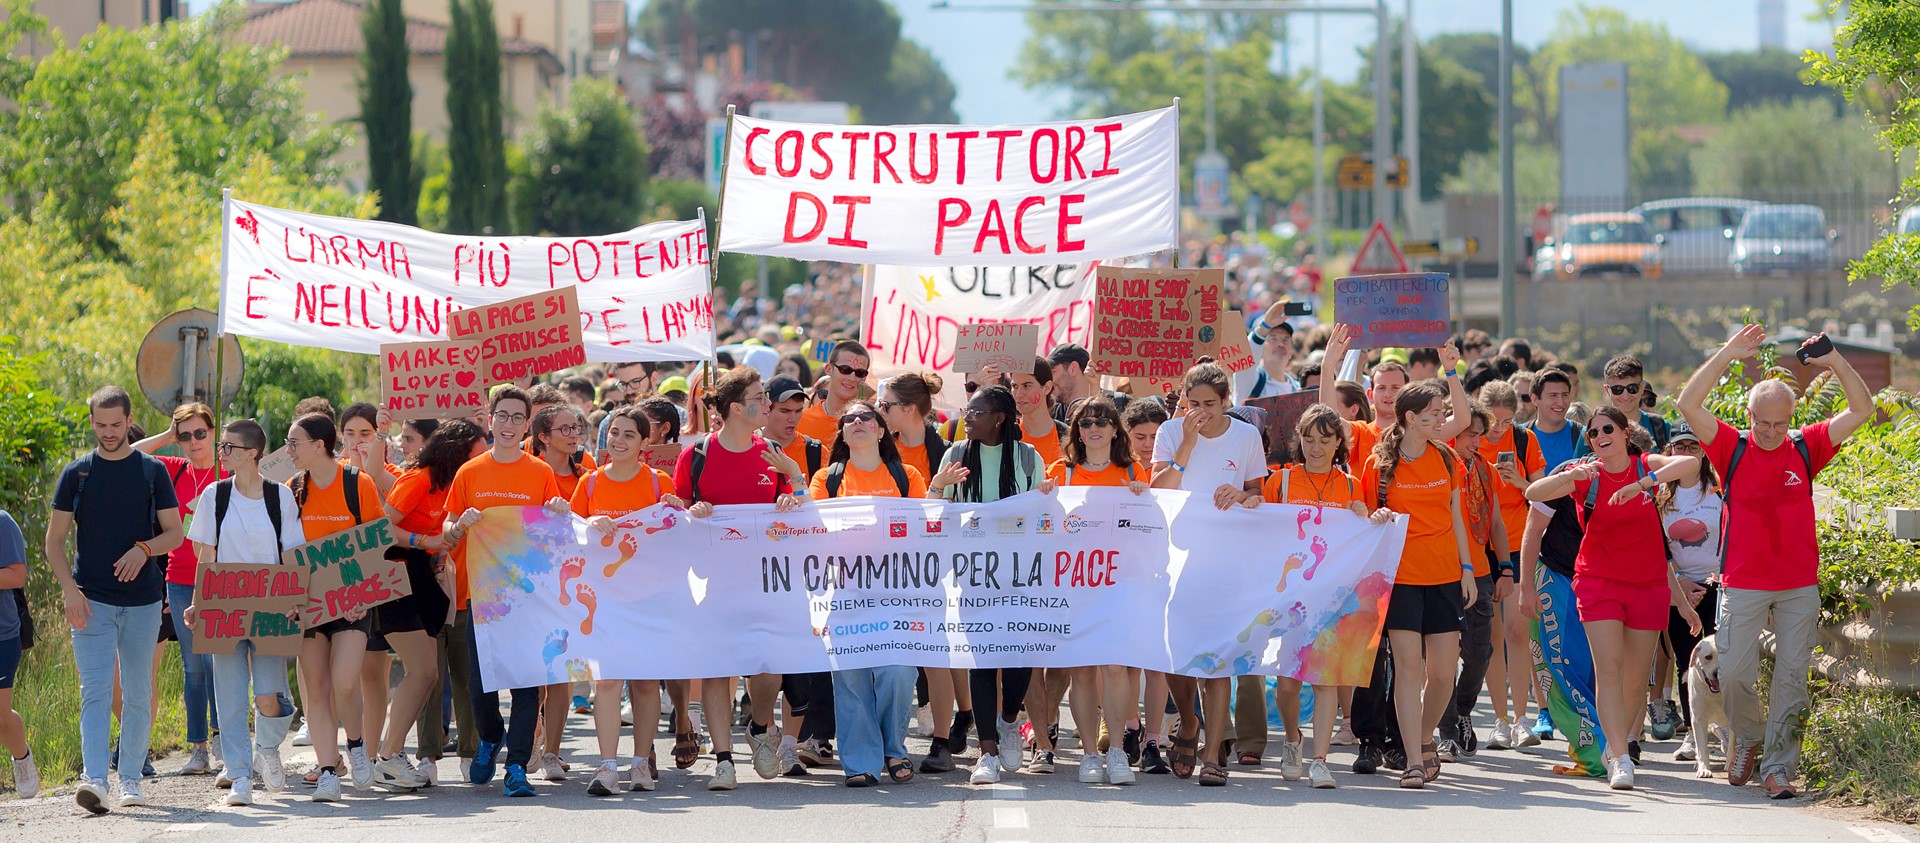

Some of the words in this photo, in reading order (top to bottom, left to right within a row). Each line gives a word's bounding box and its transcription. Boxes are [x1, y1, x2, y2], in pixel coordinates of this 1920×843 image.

[744, 122, 1123, 185] COSTRUTTORI
[782, 190, 871, 249] DI
[934, 194, 1086, 255] PACE
[284, 226, 412, 280] L'ARMA
[454, 240, 512, 288] PIÙ
[548, 226, 712, 288] POTENTE
[1097, 277, 1119, 297] MA
[1123, 279, 1150, 298] NON
[1337, 278, 1449, 294] COMBATTEREMO
[1346, 296, 1367, 306] PER
[1373, 296, 1386, 305] LA
[1379, 306, 1420, 315] QUANDO
[453, 310, 483, 337] LA
[487, 301, 536, 330] PACE
[544, 294, 566, 319] SI
[976, 325, 1023, 338] PONTI
[1345, 323, 1363, 335] ON
[482, 324, 570, 360] STRUISCE
[973, 340, 1006, 352] MURI
[388, 347, 460, 372] MAKE
[392, 373, 450, 391] LOVE
[388, 393, 429, 410] NOT
[436, 391, 482, 408] WAR
[811, 526, 828, 534] Fest
[295, 533, 355, 574] LIVING
[339, 558, 364, 587] IN
[761, 555, 791, 593] IN
[803, 551, 940, 592] CAMMINO
[952, 551, 1001, 590] PER
[1011, 551, 1043, 587] LA
[1054, 549, 1120, 588] PACE
[202, 568, 270, 600] IMAGINE
[270, 571, 305, 596] ALL
[325, 573, 391, 617] PEACE
[813, 598, 876, 612] INSIEME
[880, 597, 943, 608] CONTRO
[948, 595, 1070, 609] L'INDIFFERENZA
[199, 609, 248, 638] THE
[834, 620, 890, 636] GIUGNO
[893, 620, 926, 632] 2023
[936, 622, 994, 633] AREZZO
[1007, 621, 1071, 635] RONDINE
[827, 640, 951, 656] #UnicoNemicoèGuerra
[953, 642, 1057, 657] #OnlyEnemyisWar
